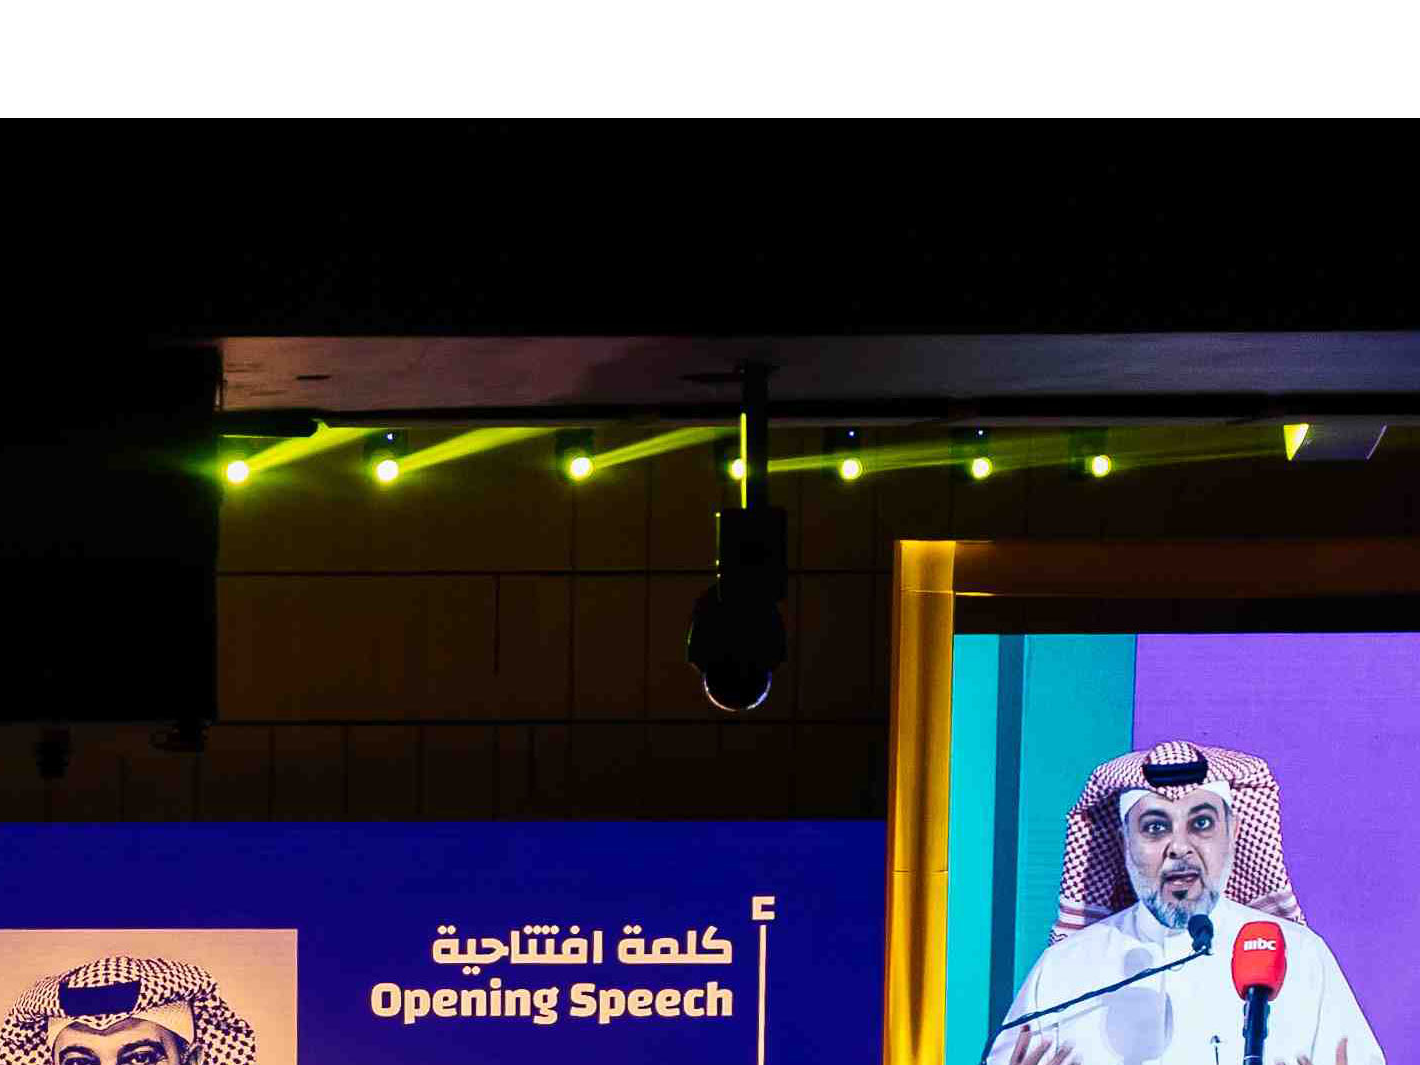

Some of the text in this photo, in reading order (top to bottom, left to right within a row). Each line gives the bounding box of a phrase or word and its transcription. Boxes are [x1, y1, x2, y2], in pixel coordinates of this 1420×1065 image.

[432, 924, 733, 976] كلمة افتتاحية
[370, 977, 733, 1025] Opening Speech
